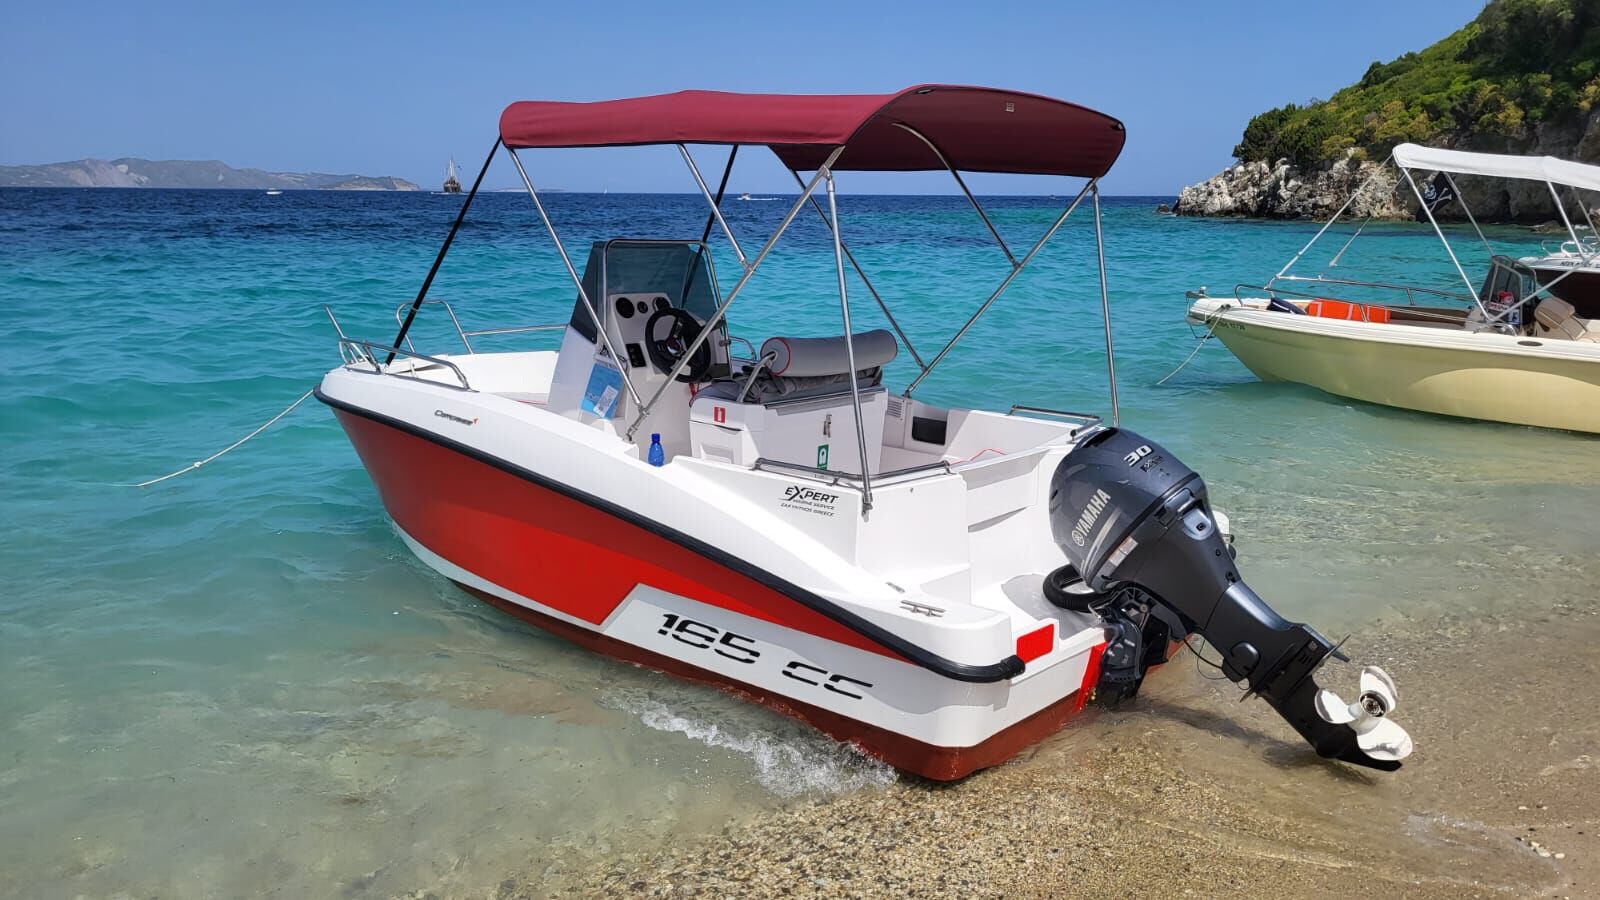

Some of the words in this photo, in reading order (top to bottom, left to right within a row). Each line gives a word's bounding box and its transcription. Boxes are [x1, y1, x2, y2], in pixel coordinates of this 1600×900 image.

[1123, 445, 1152, 467] 30
[780, 486, 839, 503] EXPERT
[813, 502, 835, 510] SERVICE
[813, 509, 835, 517] GREECE
[1075, 488, 1111, 537] YAMAHA
[657, 614, 761, 664] 165
